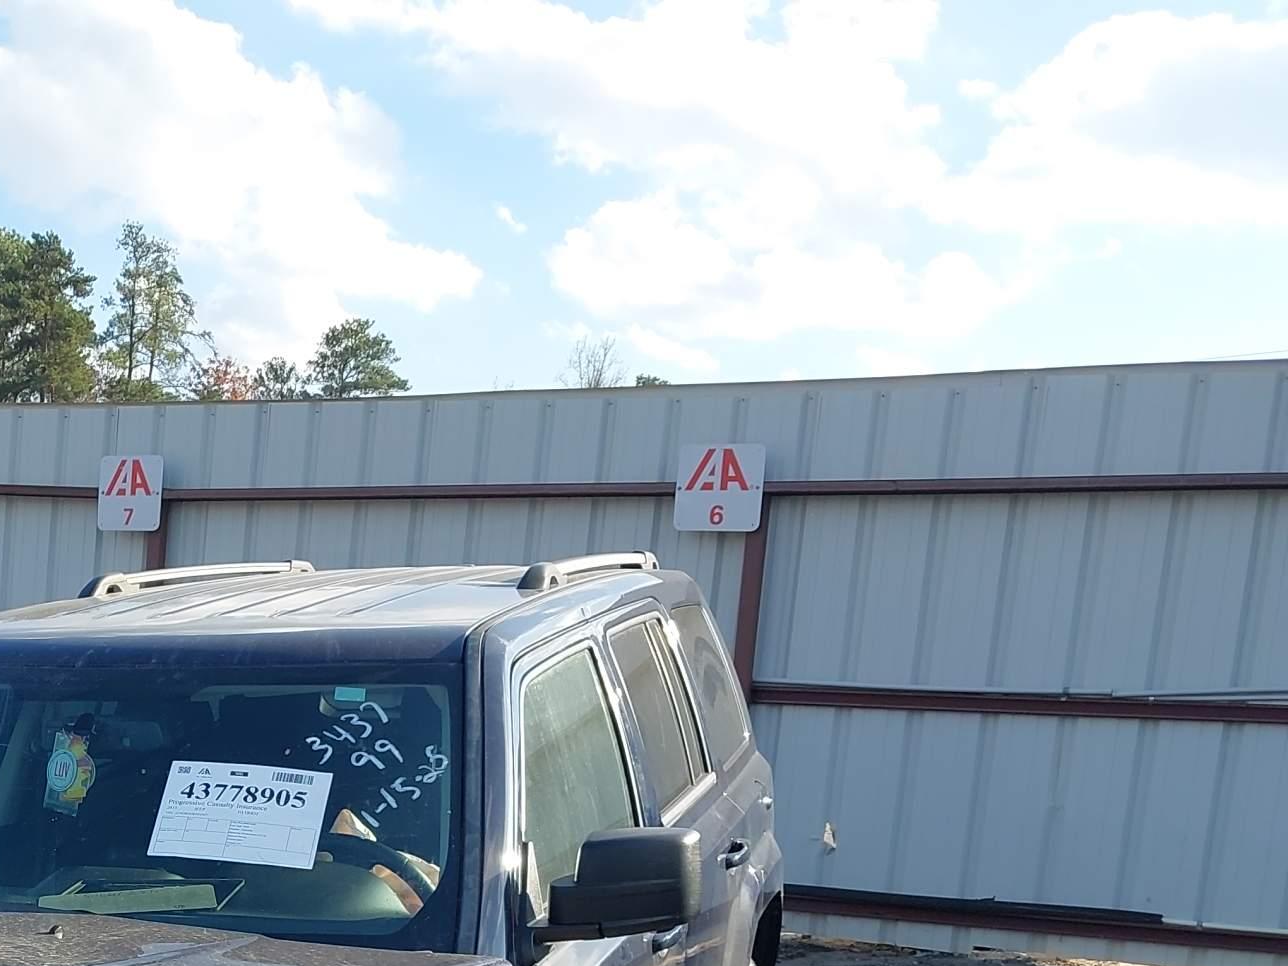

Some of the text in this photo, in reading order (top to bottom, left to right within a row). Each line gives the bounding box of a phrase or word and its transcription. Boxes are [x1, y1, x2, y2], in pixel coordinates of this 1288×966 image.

[123, 508, 134, 526] 7
[709, 504, 725, 525] 6
[305, 701, 390, 766] 3437
[350, 739, 405, 771] 99
[168, 799, 206, 807] Progressive
[206, 801, 235, 810] Casualty
[236, 803, 268, 812] Insurance
[180, 782, 309, 809] 43778905
